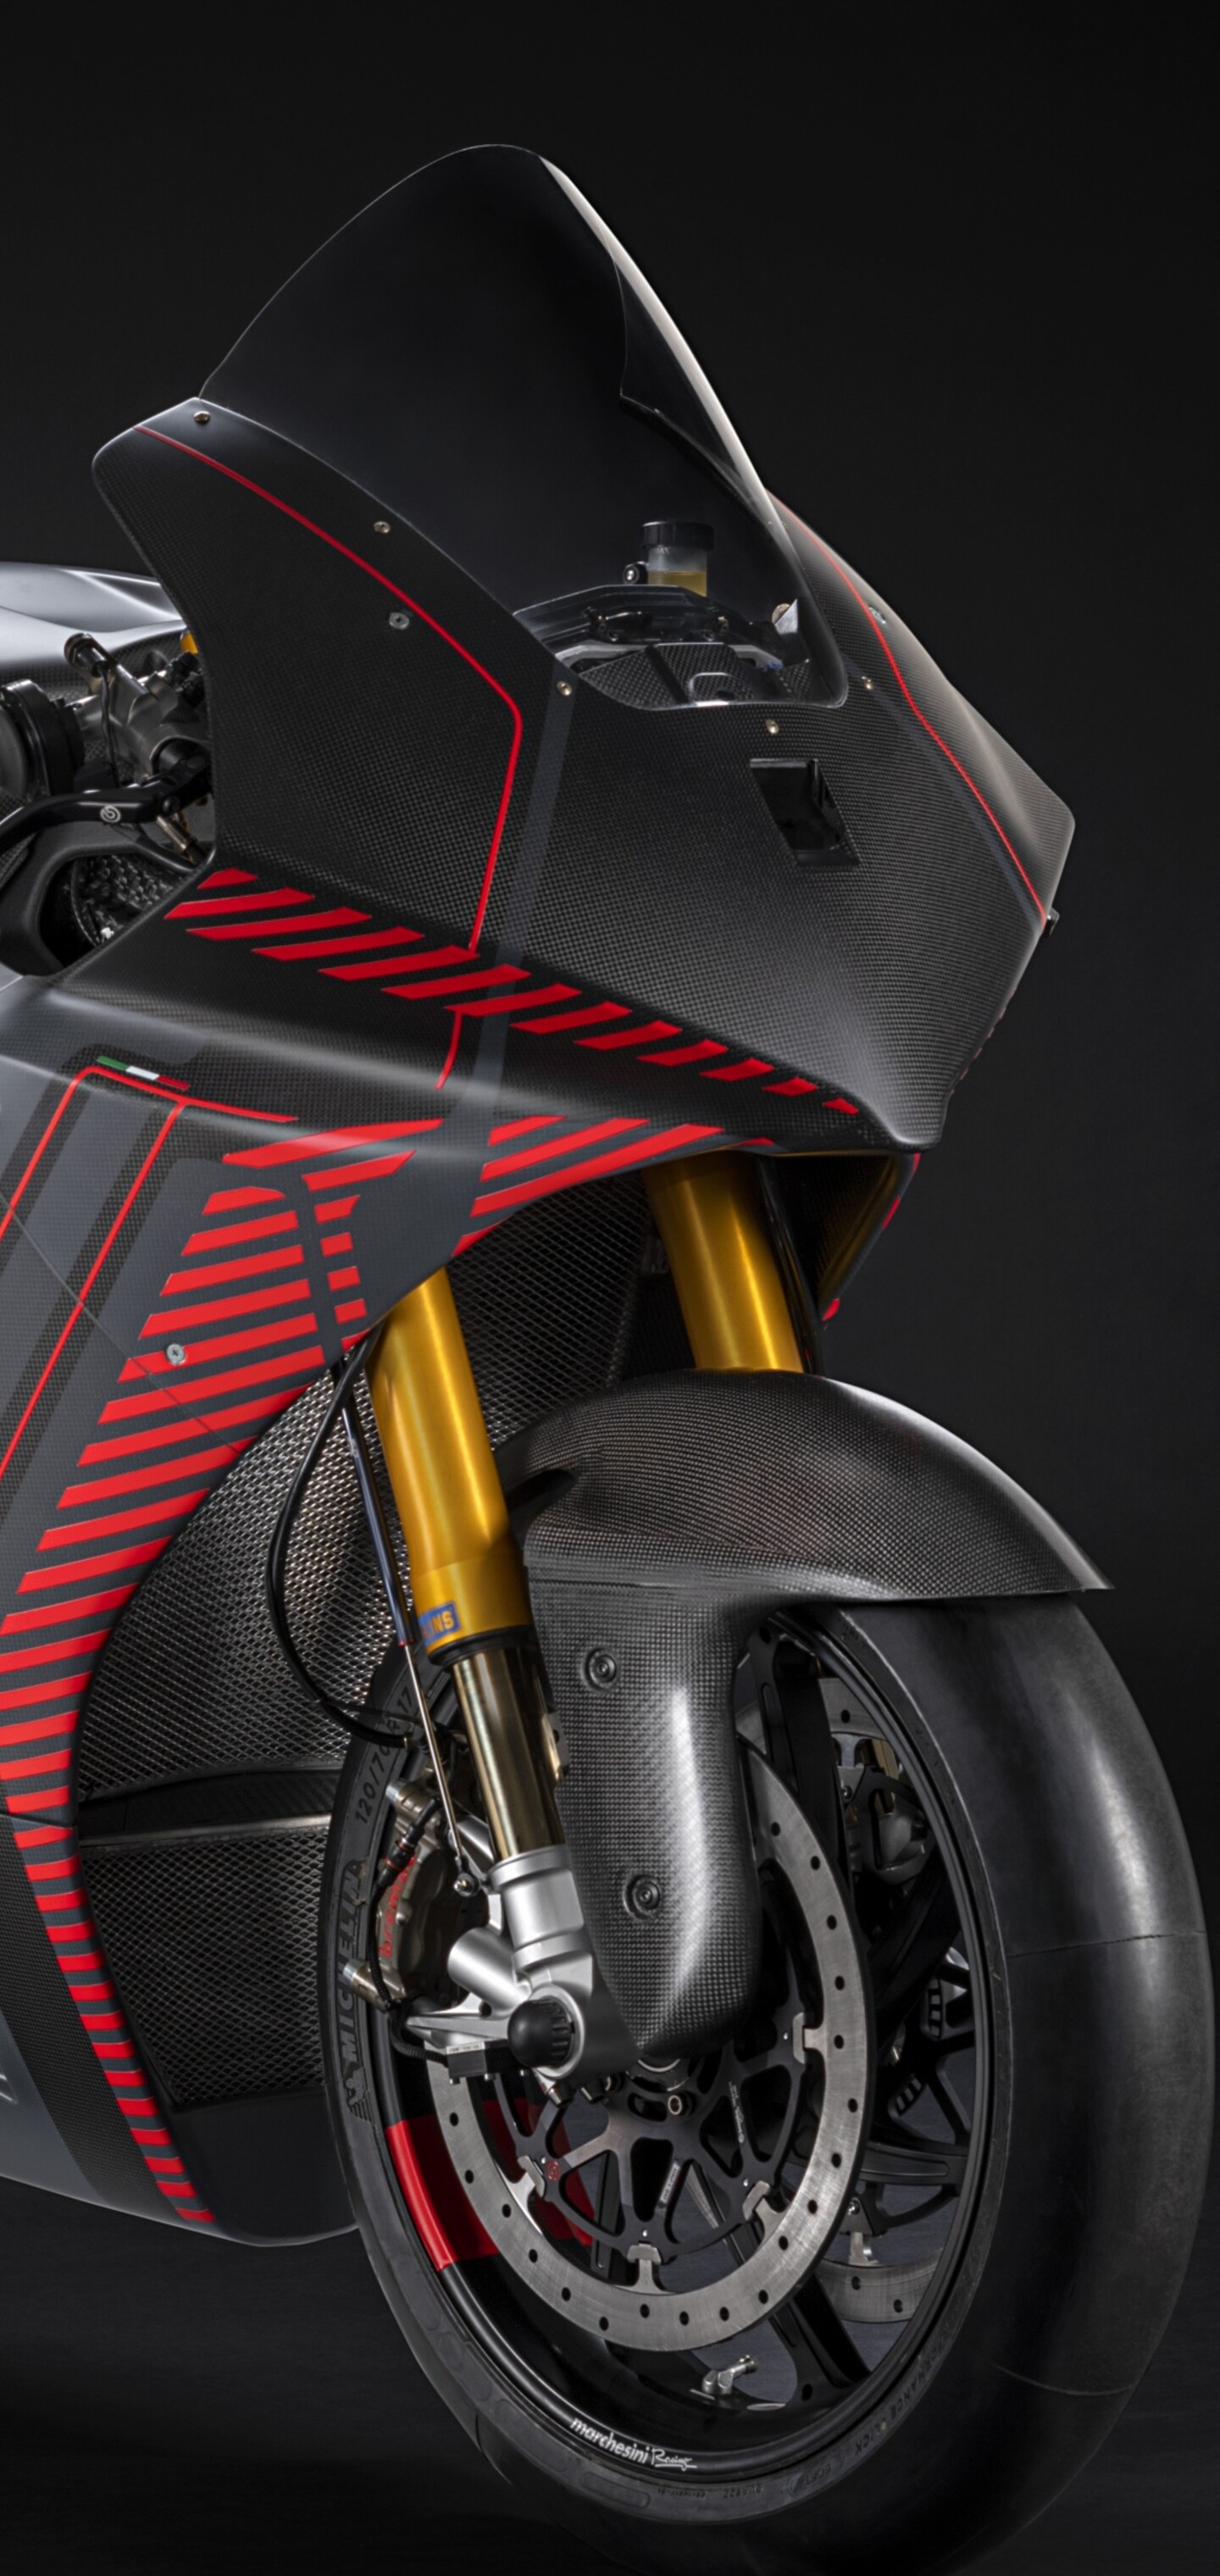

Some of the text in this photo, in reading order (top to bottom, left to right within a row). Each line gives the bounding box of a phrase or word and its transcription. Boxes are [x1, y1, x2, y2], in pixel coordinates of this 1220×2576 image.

[355, 1743, 392, 1824] 120/70
[396, 1686, 413, 1713] 17
[569, 2418, 698, 2472] marchesini Racing
